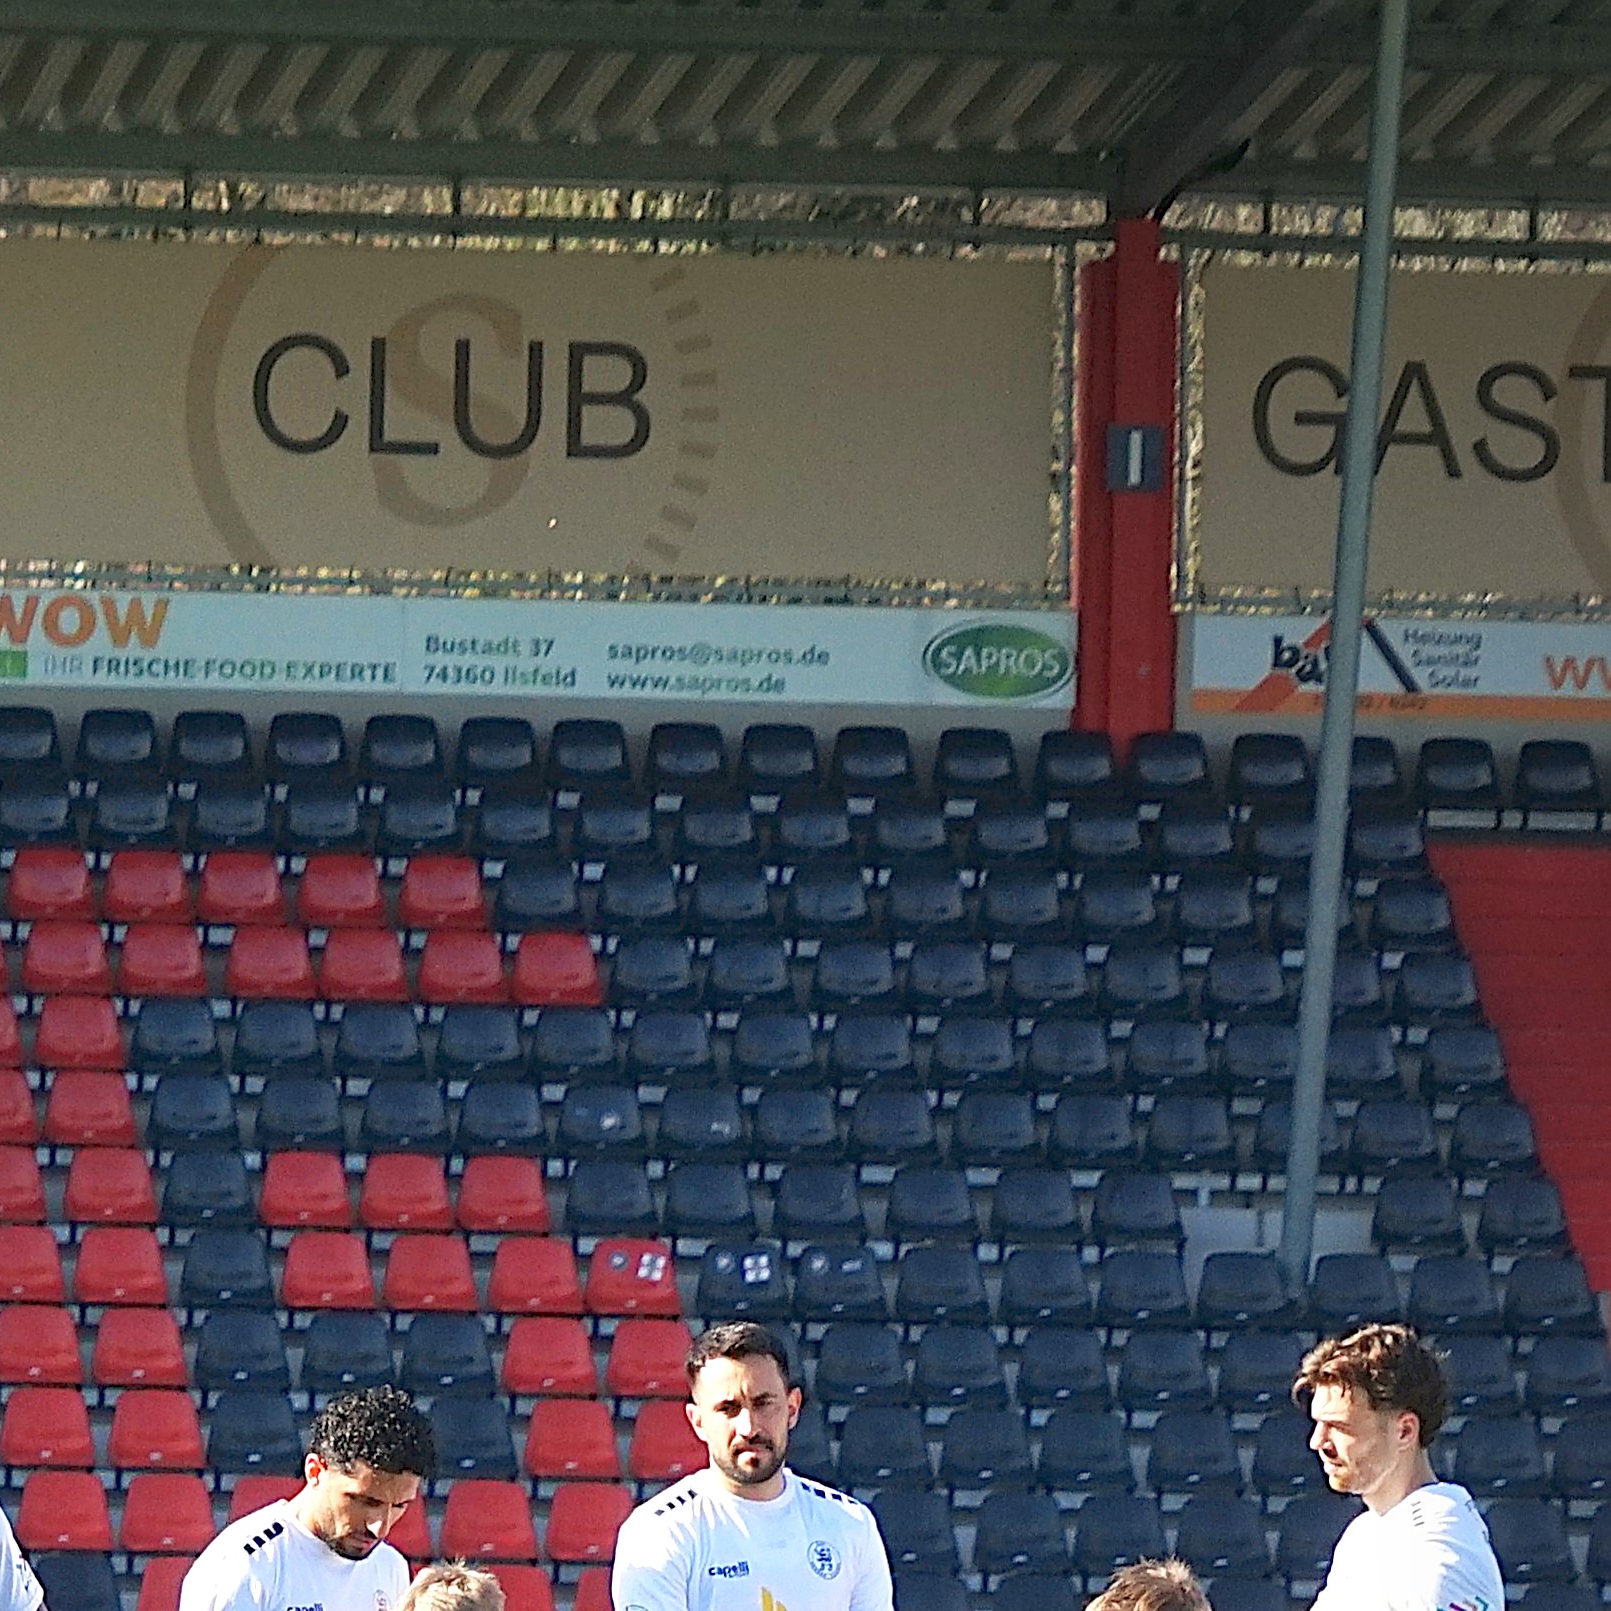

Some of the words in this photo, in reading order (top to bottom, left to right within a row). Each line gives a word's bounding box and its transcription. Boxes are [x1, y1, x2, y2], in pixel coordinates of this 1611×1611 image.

[252, 331, 653, 461] CLUB
[939, 647, 1061, 678] SAPROS
[606, 672, 786, 695] www.sapros.de
[708, 1560, 750, 1578] capelli
